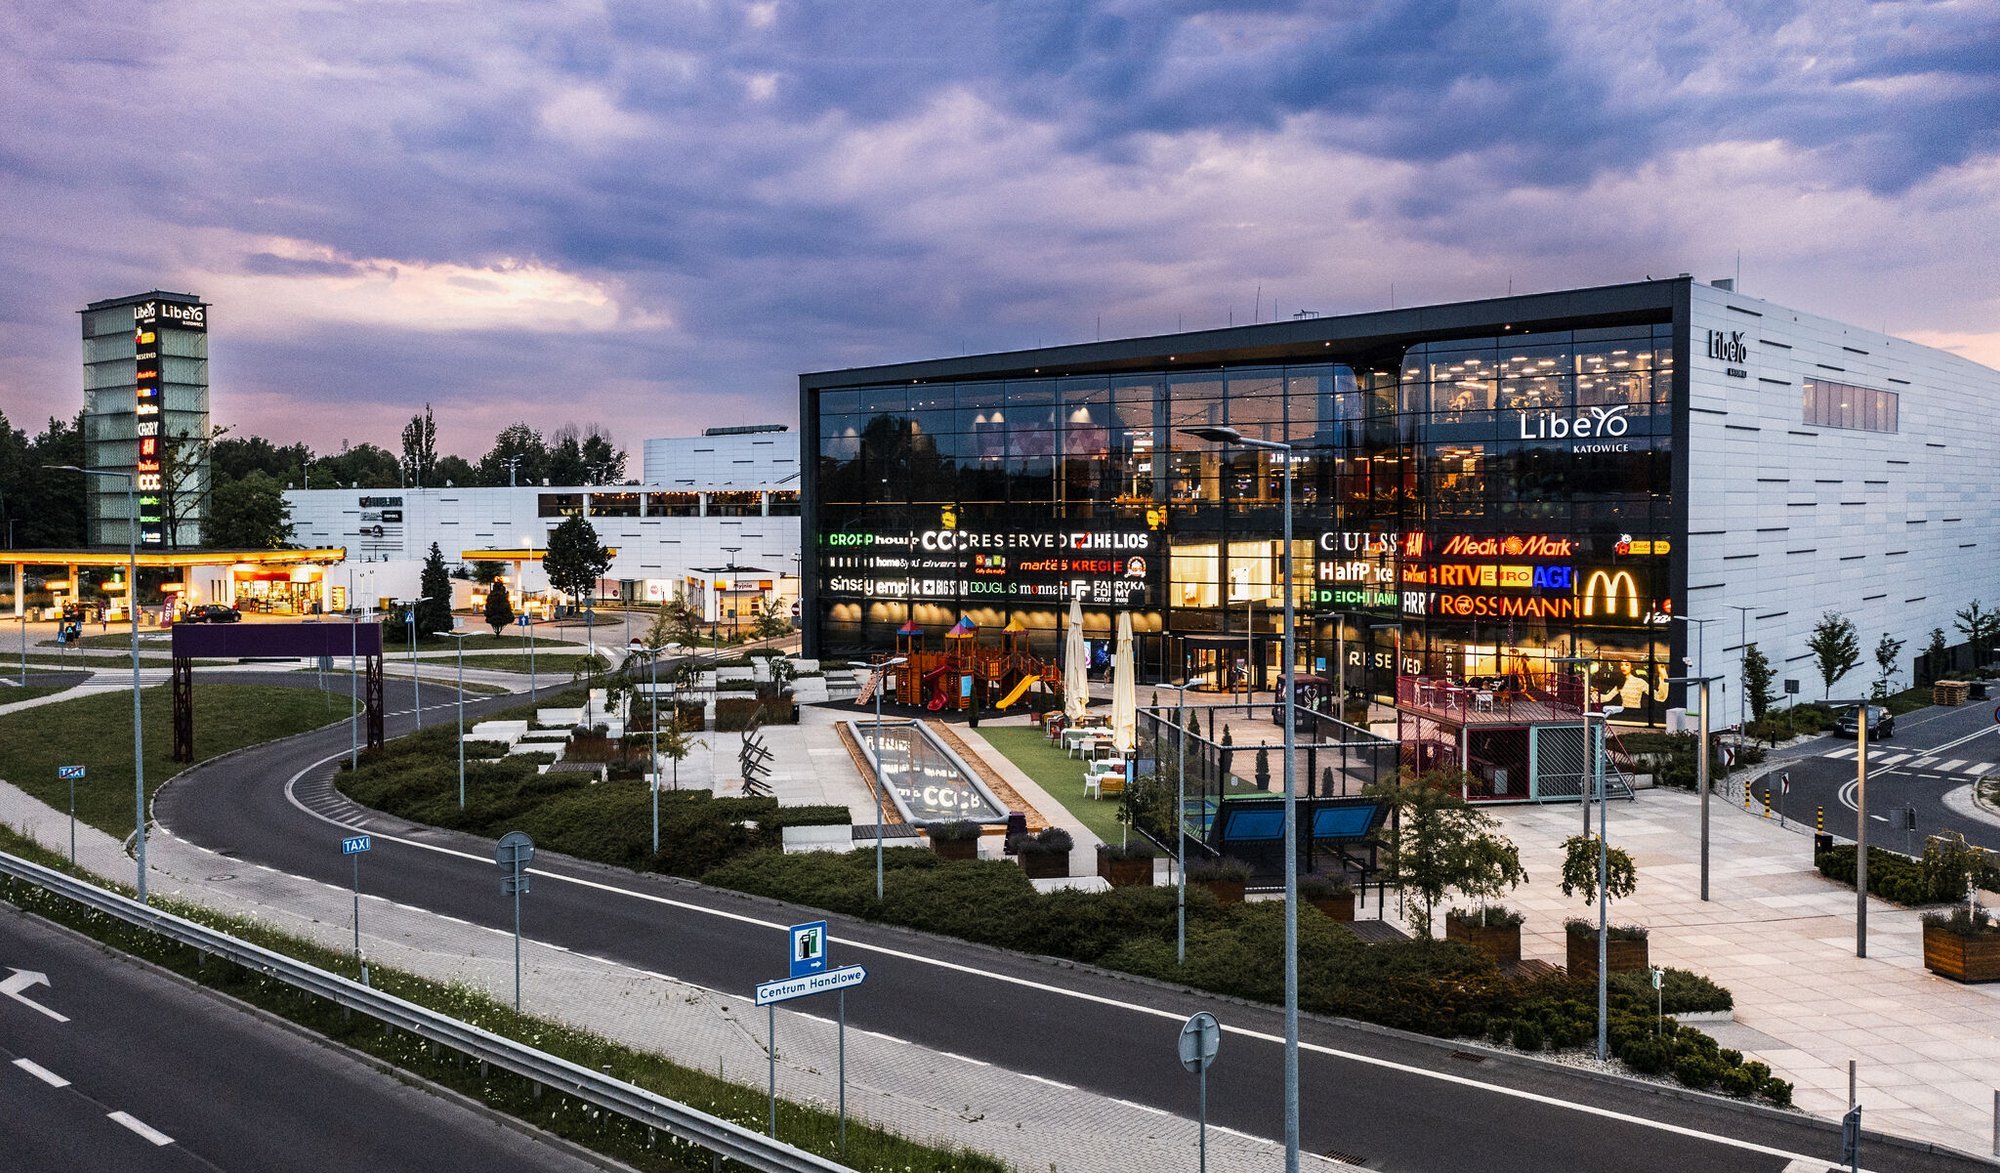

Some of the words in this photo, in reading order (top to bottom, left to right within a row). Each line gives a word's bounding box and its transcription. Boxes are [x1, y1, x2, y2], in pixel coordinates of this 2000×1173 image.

[138, 422, 158, 436] CARRY
[1573, 443, 1629, 453] KATOWICE
[139, 474, 161, 490] CCC
[922, 531, 968, 550] CCC
[969, 534, 1068, 547] RESERVED
[1094, 534, 1149, 548] HELIOS
[1518, 535, 1572, 556] Mark
[1320, 561, 1394, 582] HalfPice
[1441, 564, 1480, 586] RTV
[876, 576, 921, 597] empik
[936, 580, 949, 596] BIG
[970, 582, 1018, 594] DOUGLS
[1441, 595, 1580, 618] ROSSMANN
[61, 767, 84, 778] TAXI
[344, 838, 369, 852] TAXI
[760, 983, 806, 999] Centrum
[810, 970, 862, 989] Handlowe
